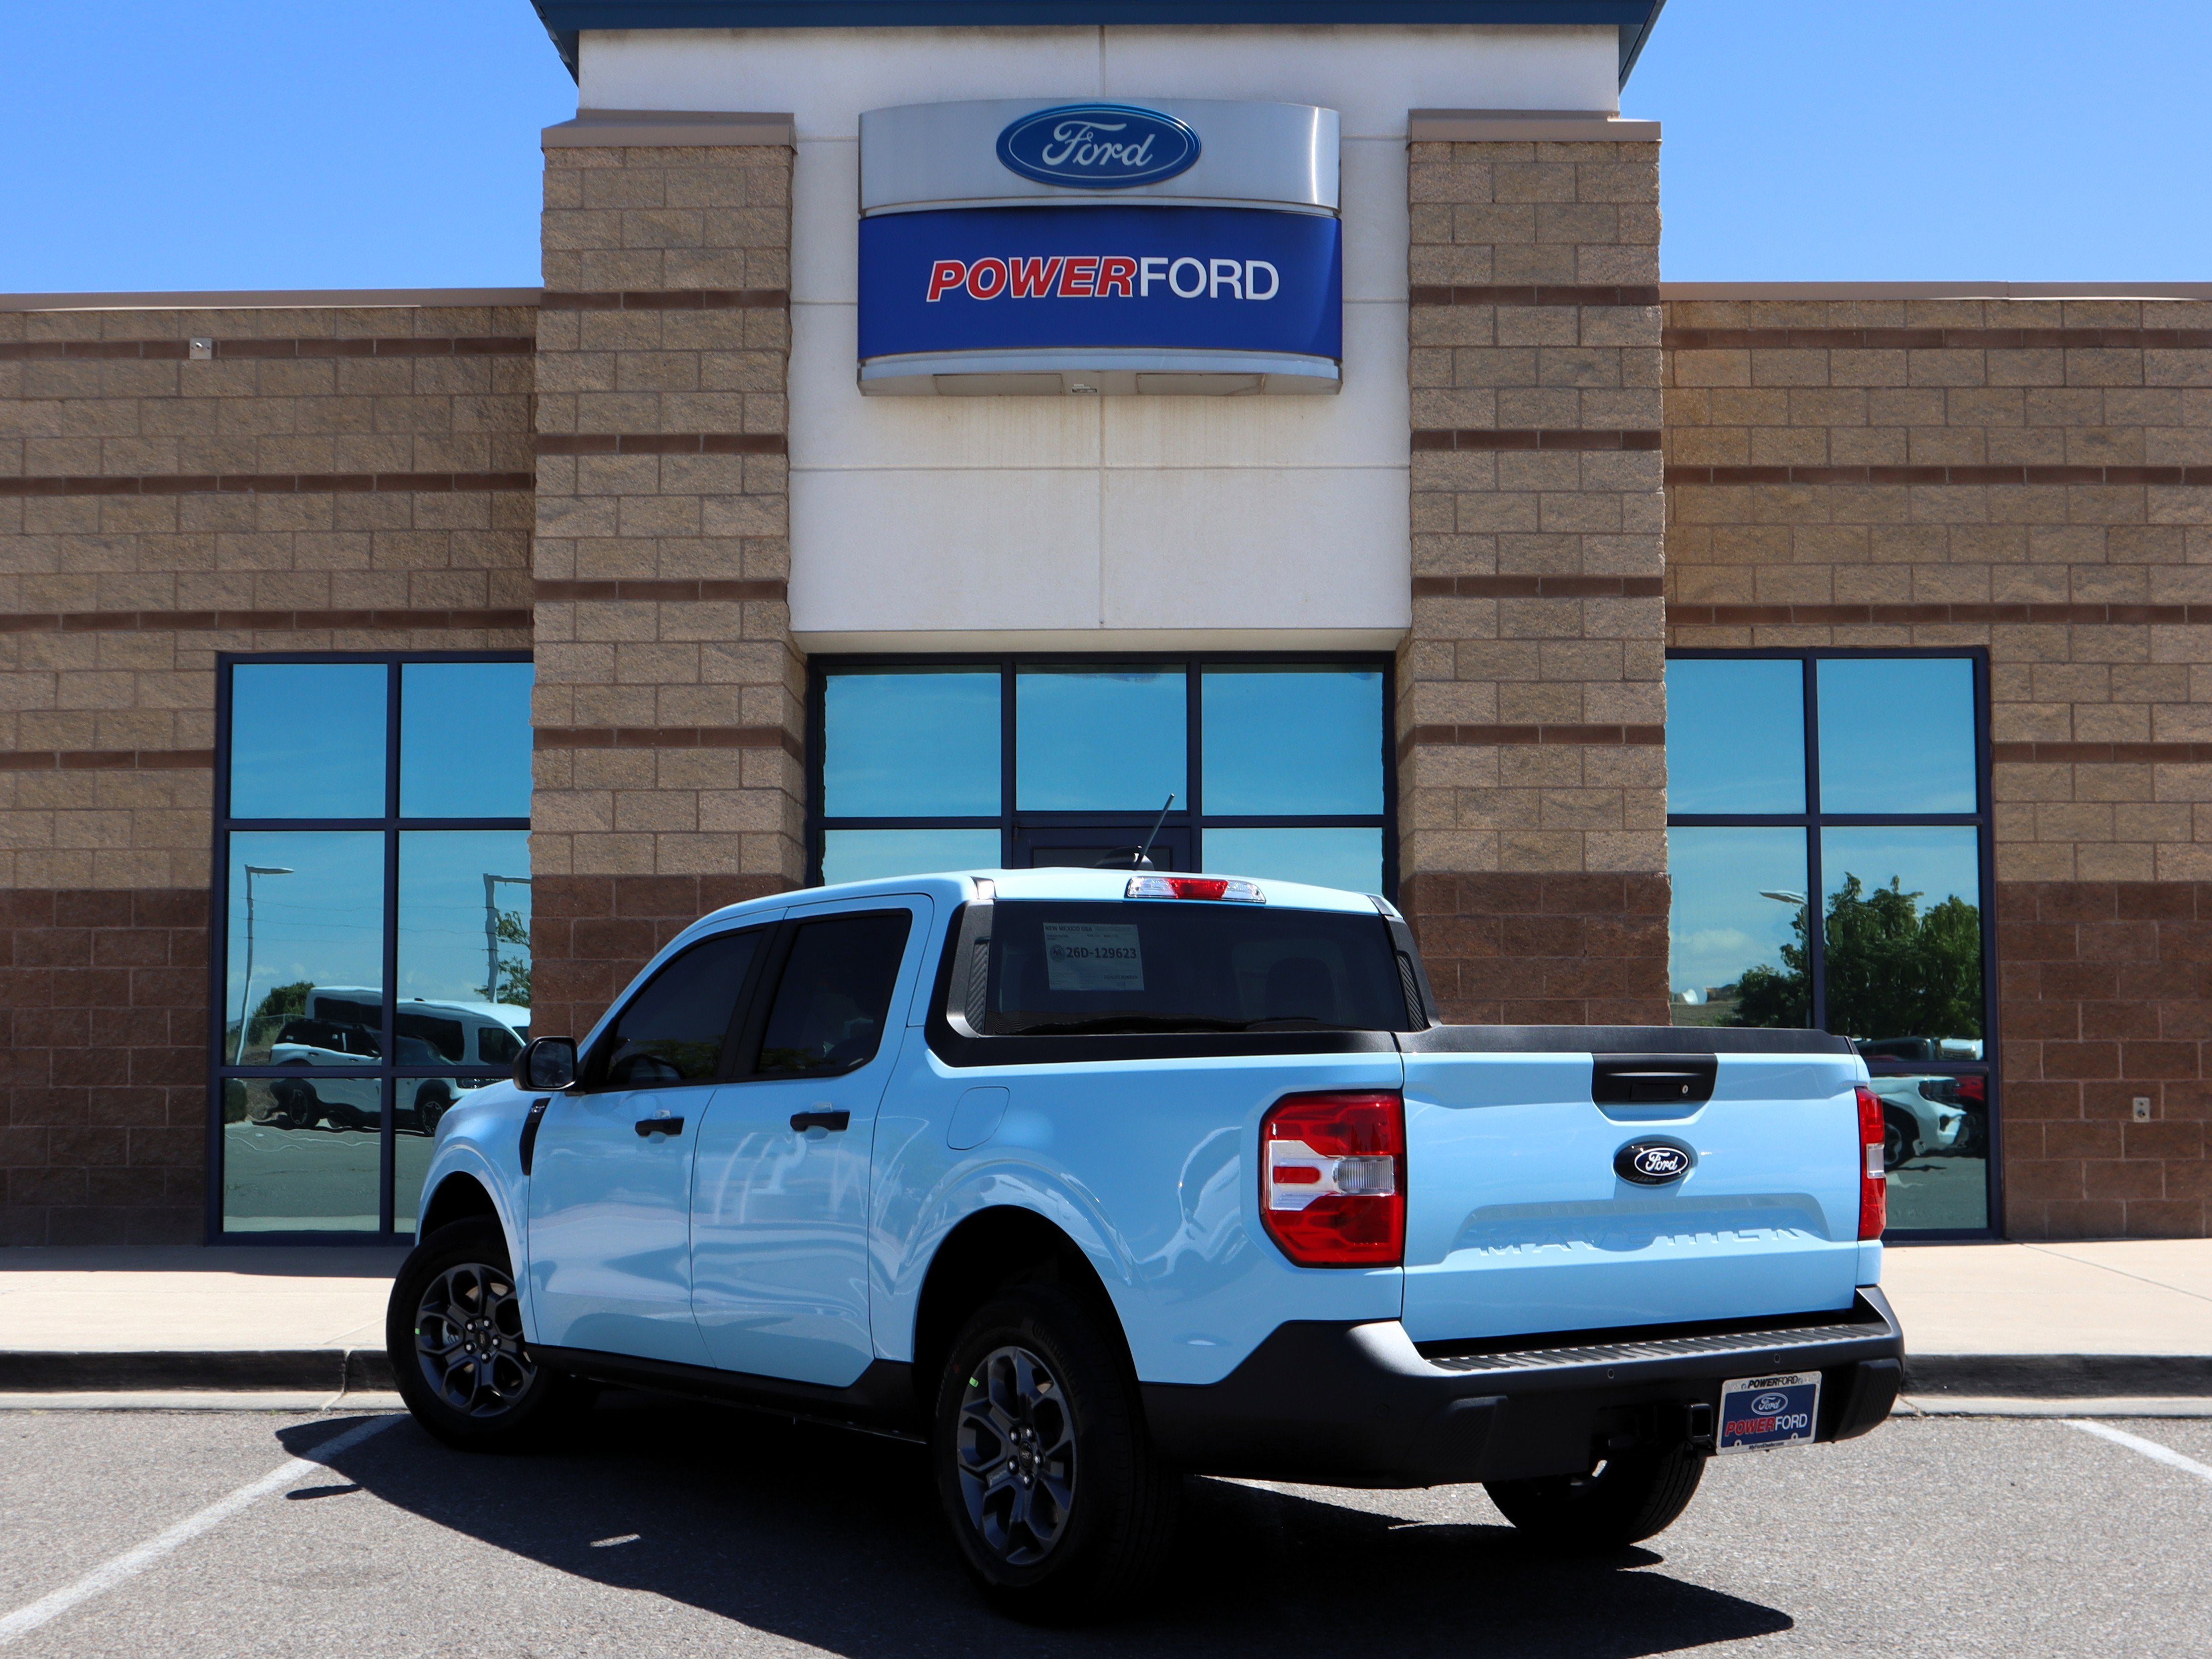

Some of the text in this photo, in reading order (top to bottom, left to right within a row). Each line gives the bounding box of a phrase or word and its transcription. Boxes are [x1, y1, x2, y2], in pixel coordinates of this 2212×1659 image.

[1041, 120, 1156, 167] Ford
[925, 255, 1280, 303] POWERFORD
[1066, 947, 1137, 959] 26D-129623
[1645, 1151, 1679, 1172] Ford
[1747, 1375, 1798, 1389] POWERFORD
[1758, 1397, 1781, 1411] Ford
[1725, 1414, 1808, 1437] POWERFORD
